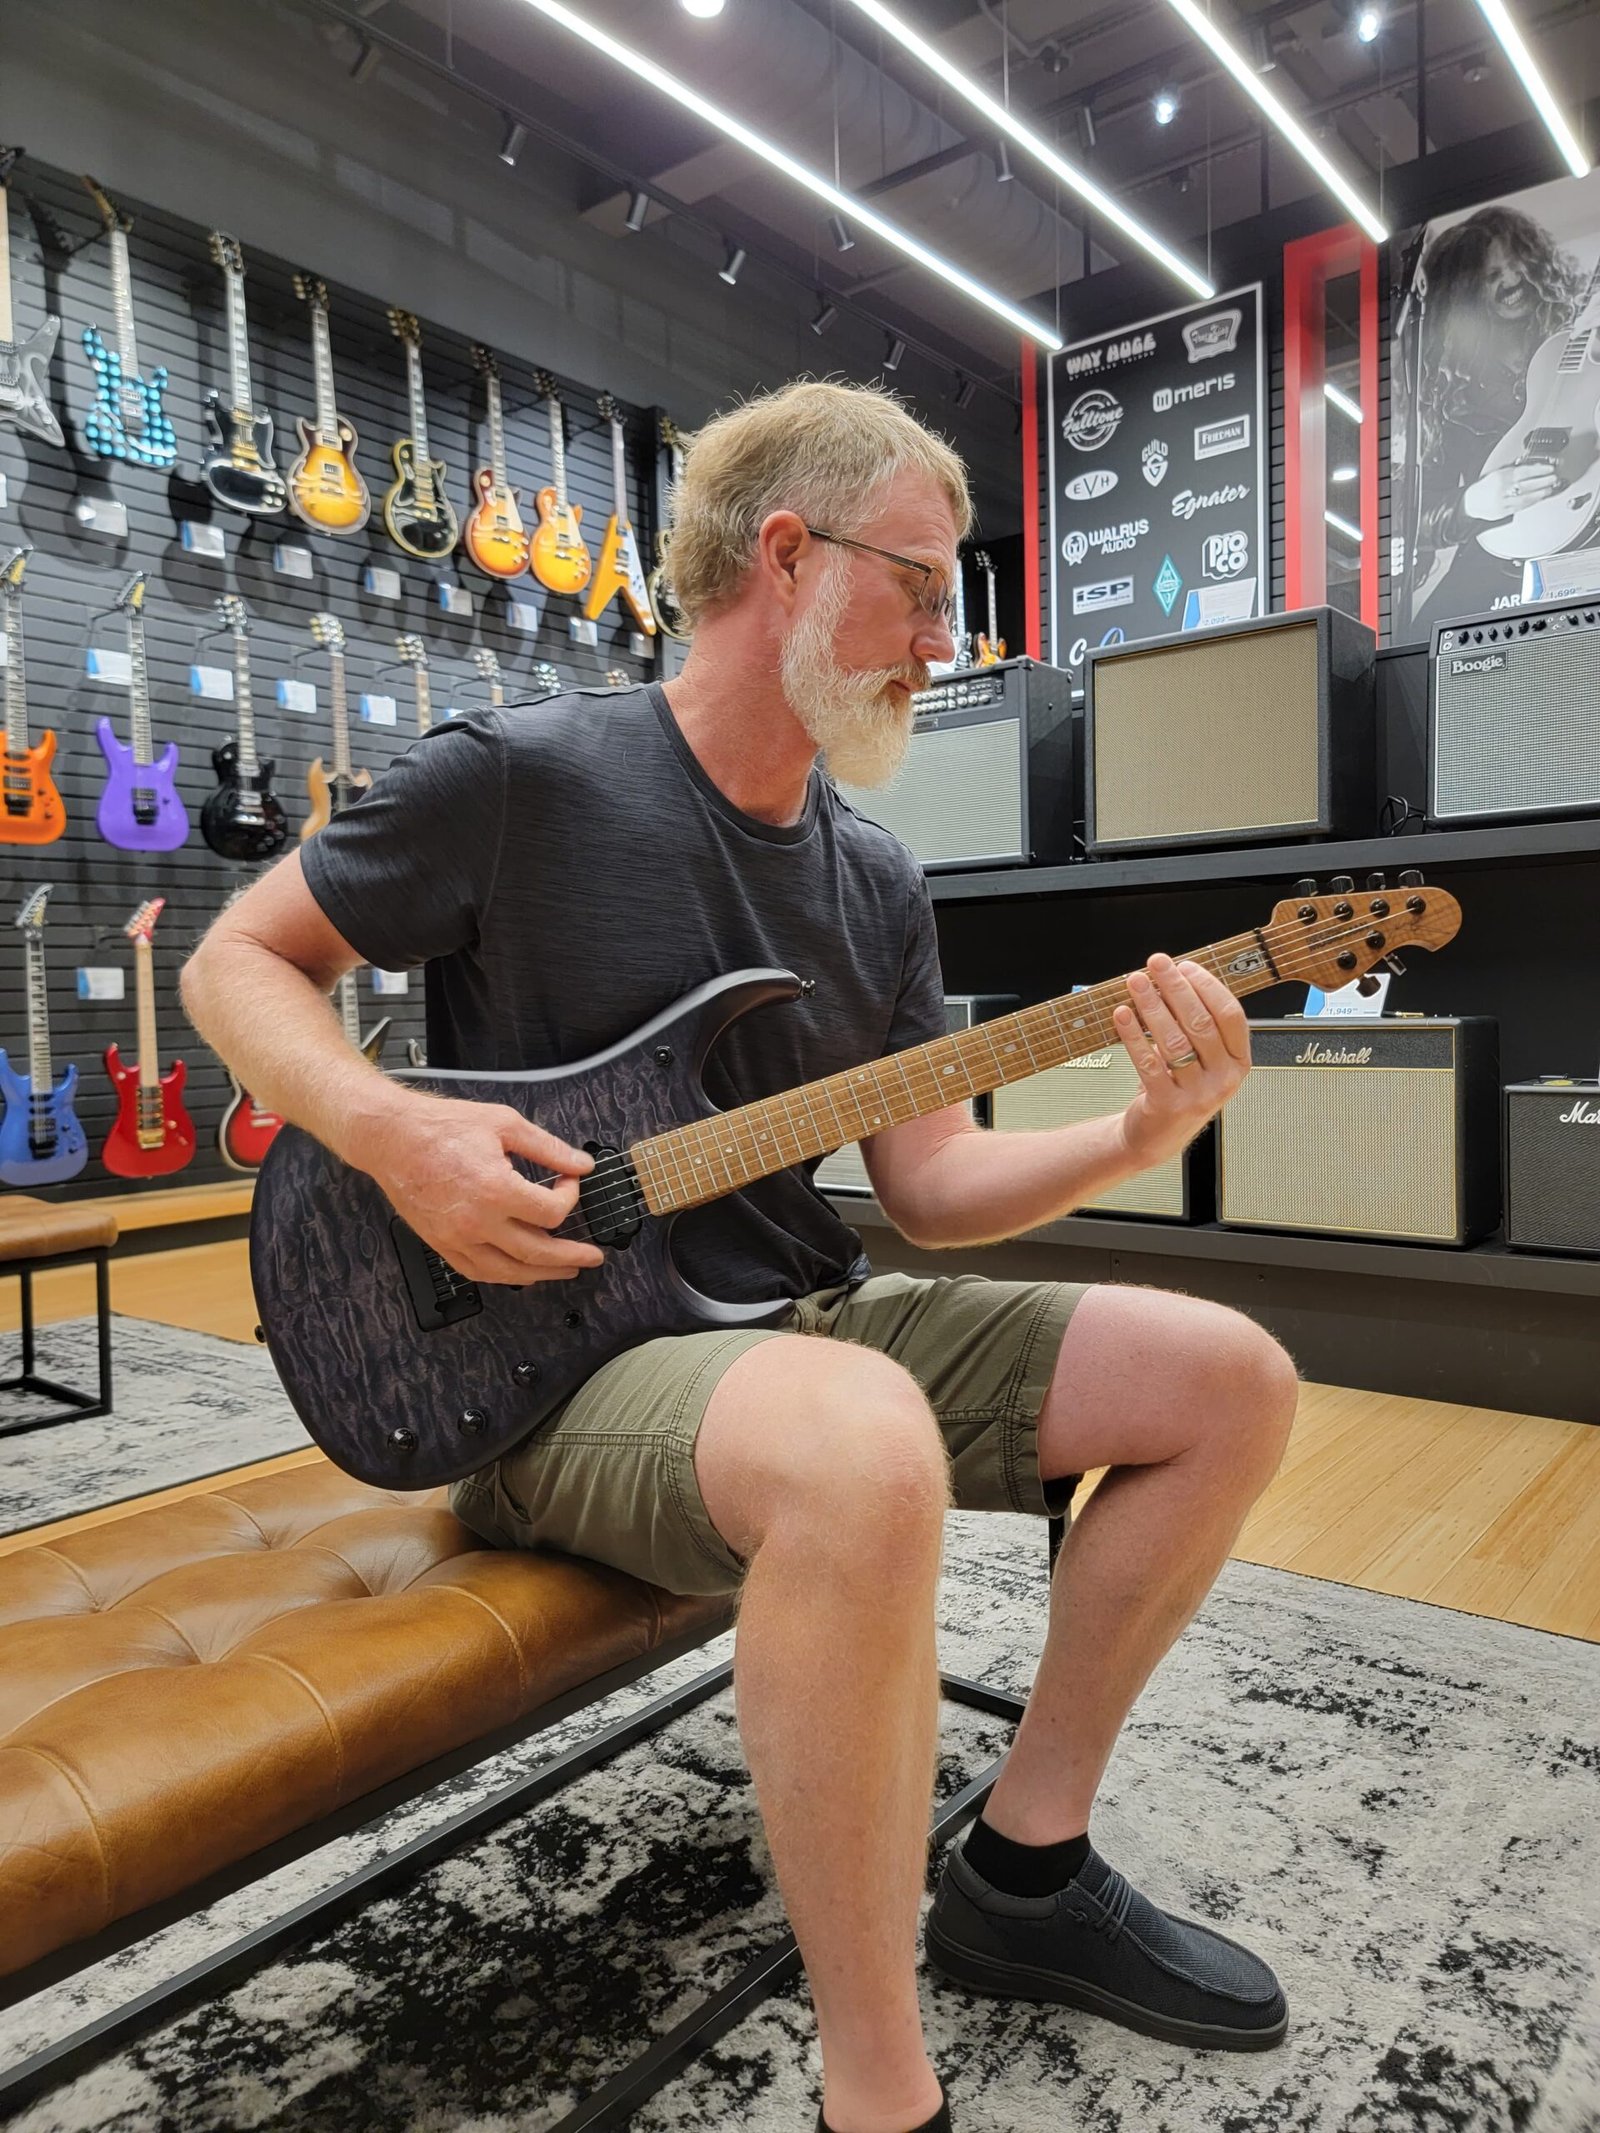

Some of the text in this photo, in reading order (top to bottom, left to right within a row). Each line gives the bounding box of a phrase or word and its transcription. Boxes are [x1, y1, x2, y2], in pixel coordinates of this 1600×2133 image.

[1066, 349, 1103, 375] WAY
[1106, 332, 1157, 363] HUGE
[1174, 373, 1236, 404] meris
[1062, 407, 1124, 439] Fulltone
[1201, 426, 1241, 445] FRIEDMAN
[1141, 438, 1169, 463] GUILD
[1073, 475, 1110, 497] EVH
[1171, 484, 1250, 520] Egnater
[1088, 518, 1150, 547] WALRUS
[1101, 536, 1137, 555] AUDIO
[1451, 654, 1504, 674] Boogie
[1296, 1042, 1373, 1065] Marshall
